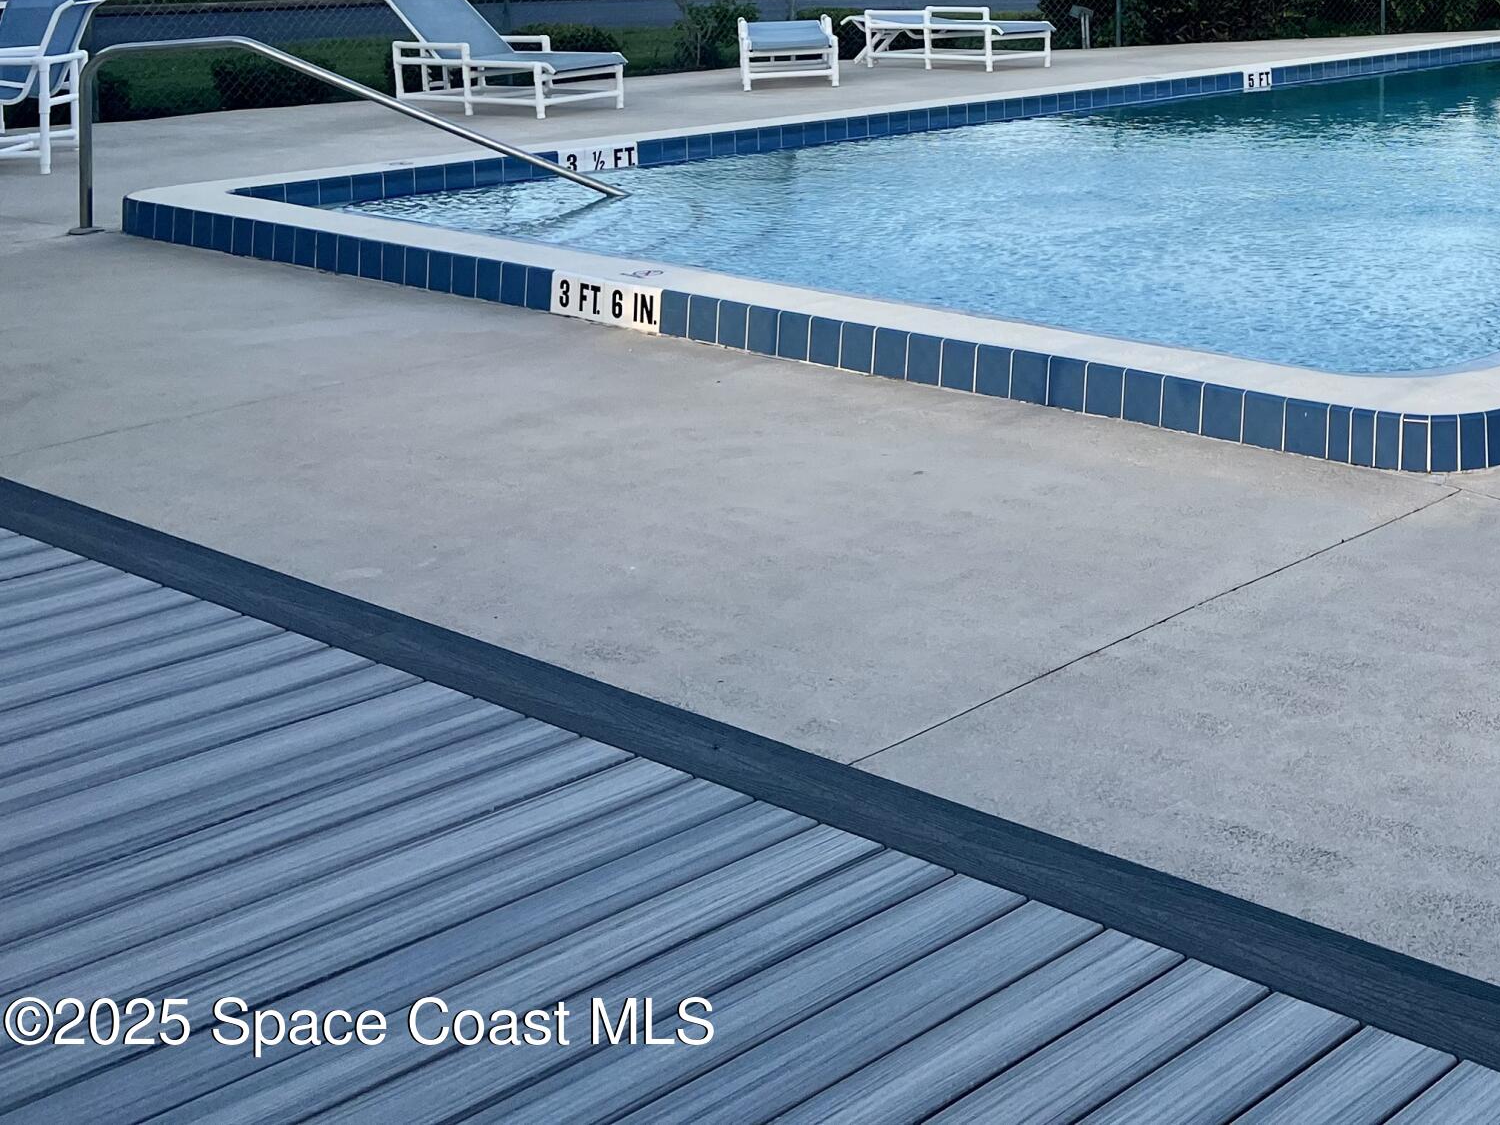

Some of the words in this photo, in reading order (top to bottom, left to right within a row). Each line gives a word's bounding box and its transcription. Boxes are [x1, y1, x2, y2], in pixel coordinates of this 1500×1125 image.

[1247, 73, 1255, 88] 5
[565, 154, 578, 171] 3
[559, 279, 571, 308] 3
[578, 282, 601, 315] FT.
[611, 289, 624, 319] 6
[632, 292, 657, 326] IN.
